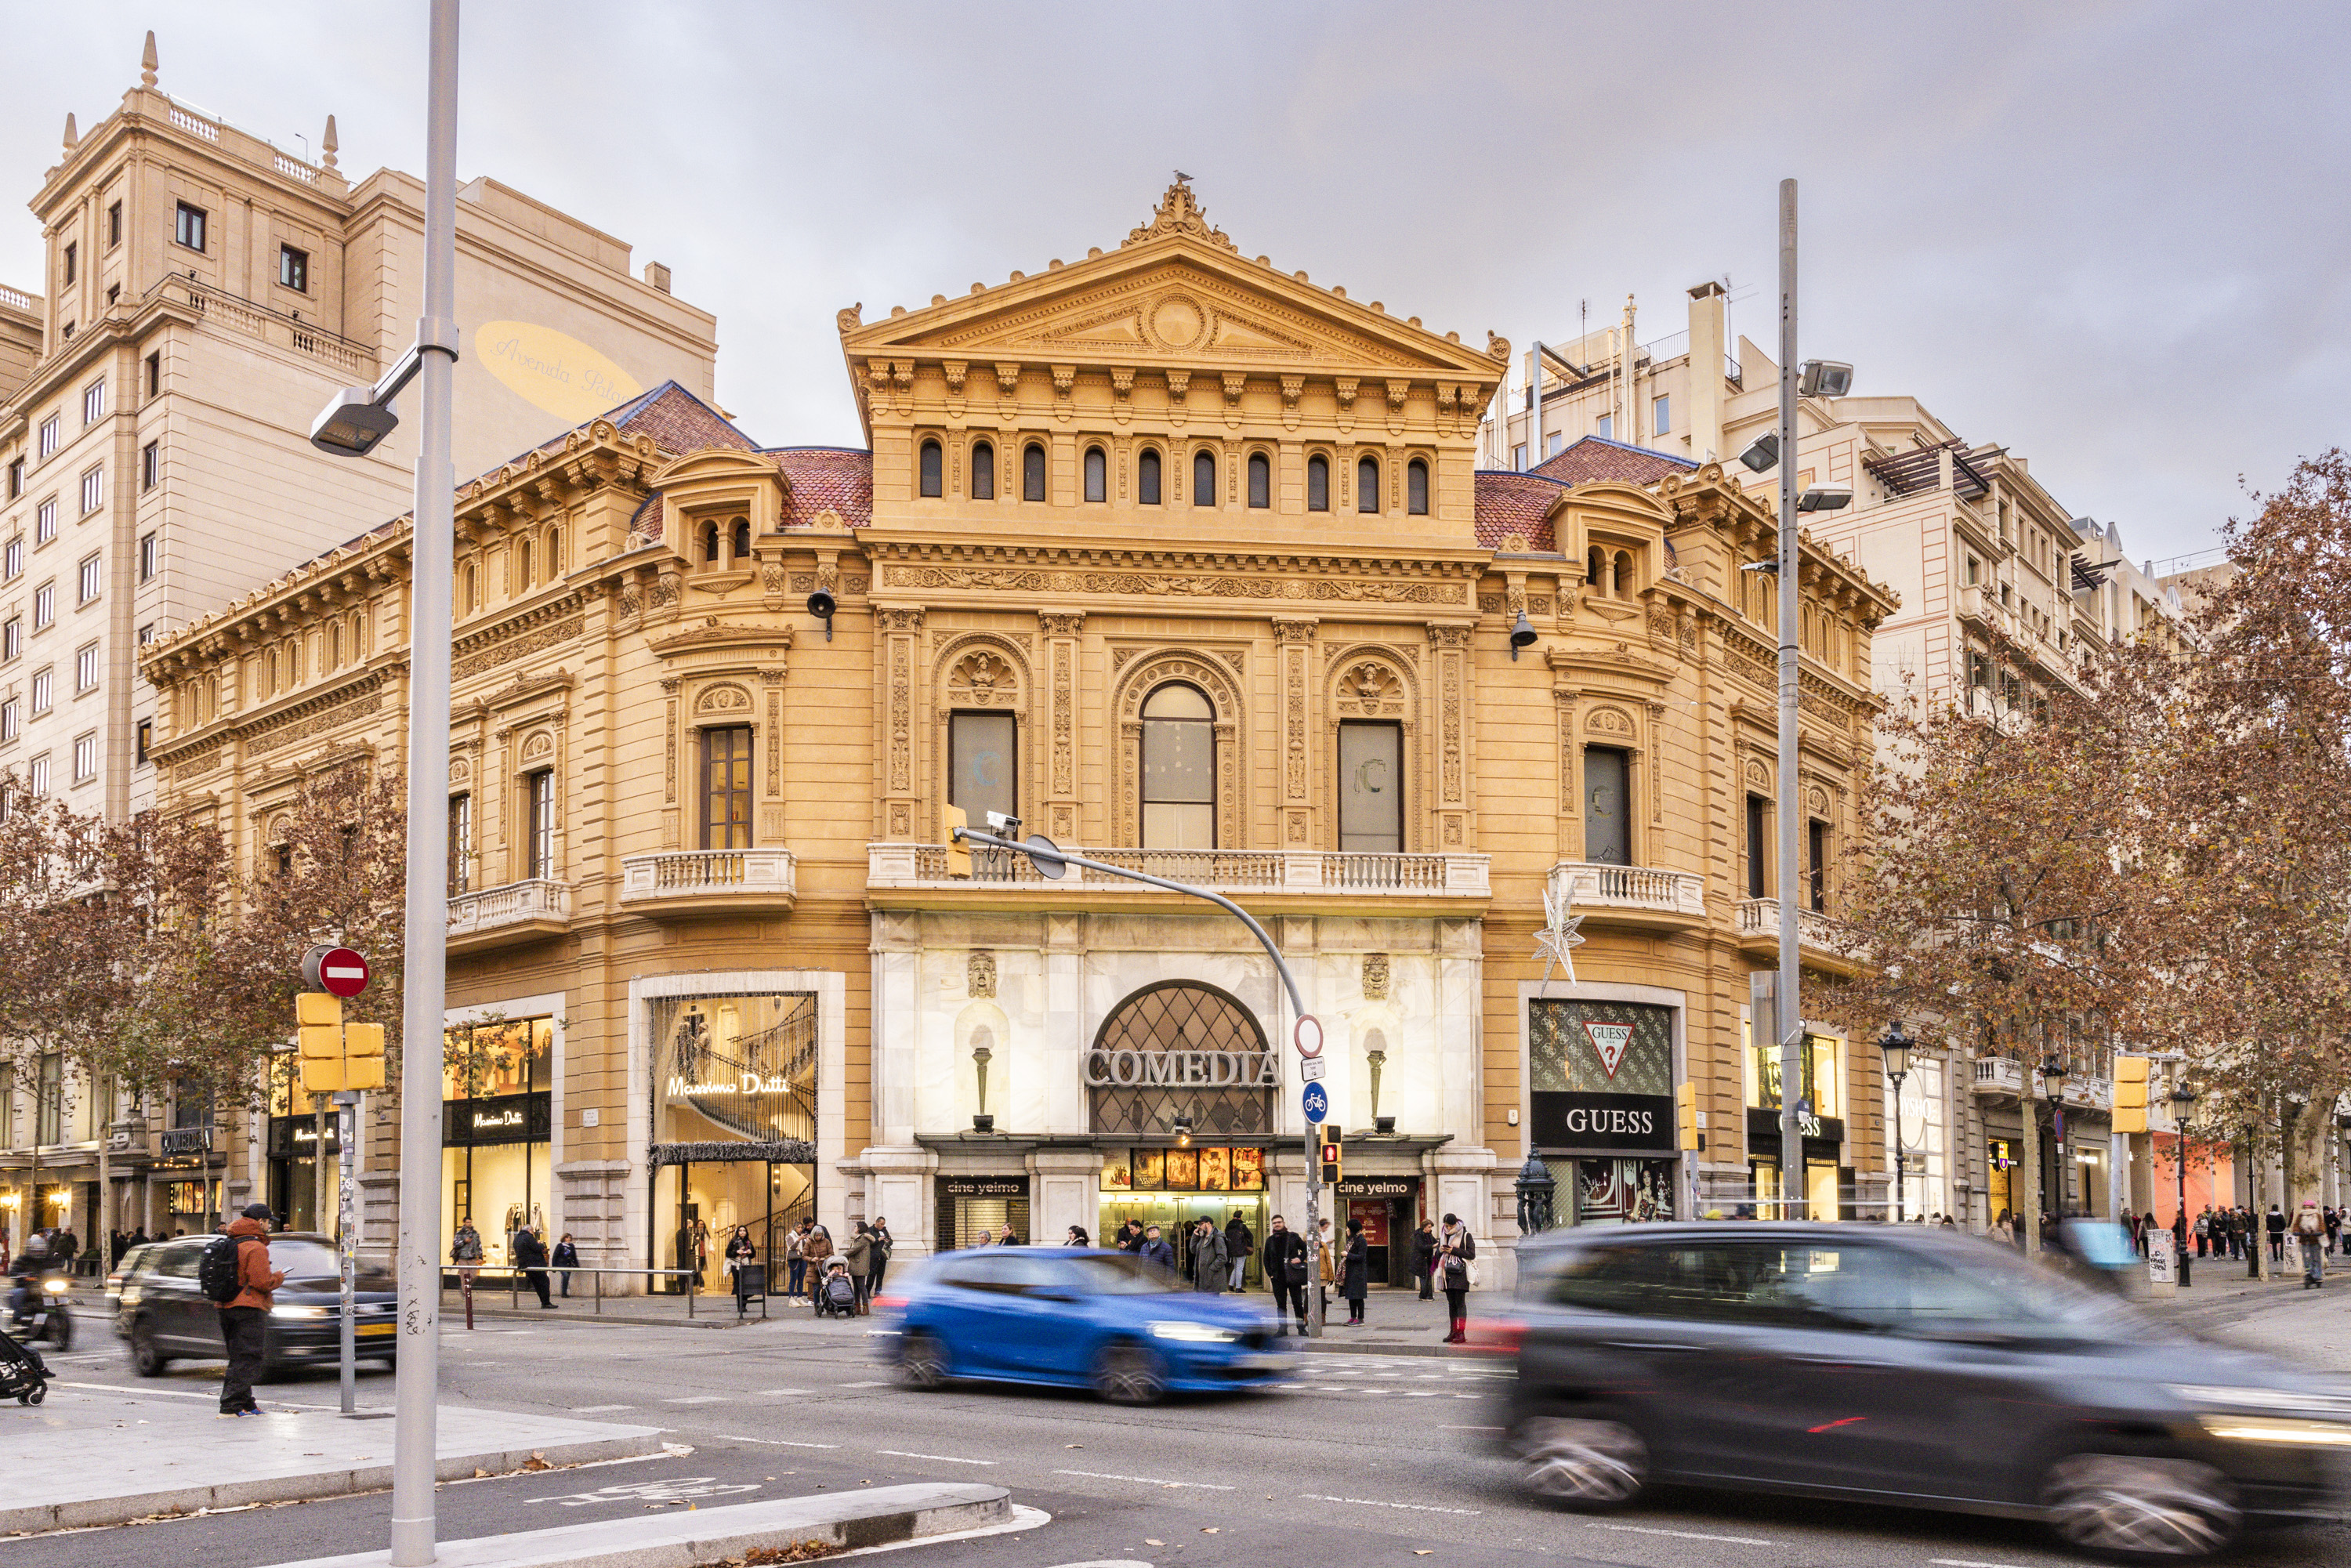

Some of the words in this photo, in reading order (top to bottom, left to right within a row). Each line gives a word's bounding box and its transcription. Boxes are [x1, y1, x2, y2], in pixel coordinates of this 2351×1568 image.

[490, 339, 570, 384] Avenida
[1592, 1027, 1628, 1041] GUESS
[1081, 1048, 1284, 1087] COMEDIA
[668, 1076, 737, 1096] Massimo
[741, 1074, 790, 1094] Dutti
[473, 1113, 503, 1128] Massimo
[504, 1110, 523, 1125] Dutti
[1566, 1109, 1653, 1134] GUESS
[947, 1181, 975, 1193] cine
[1338, 1181, 1365, 1193] cine
[1367, 1182, 1408, 1195] yelmo
